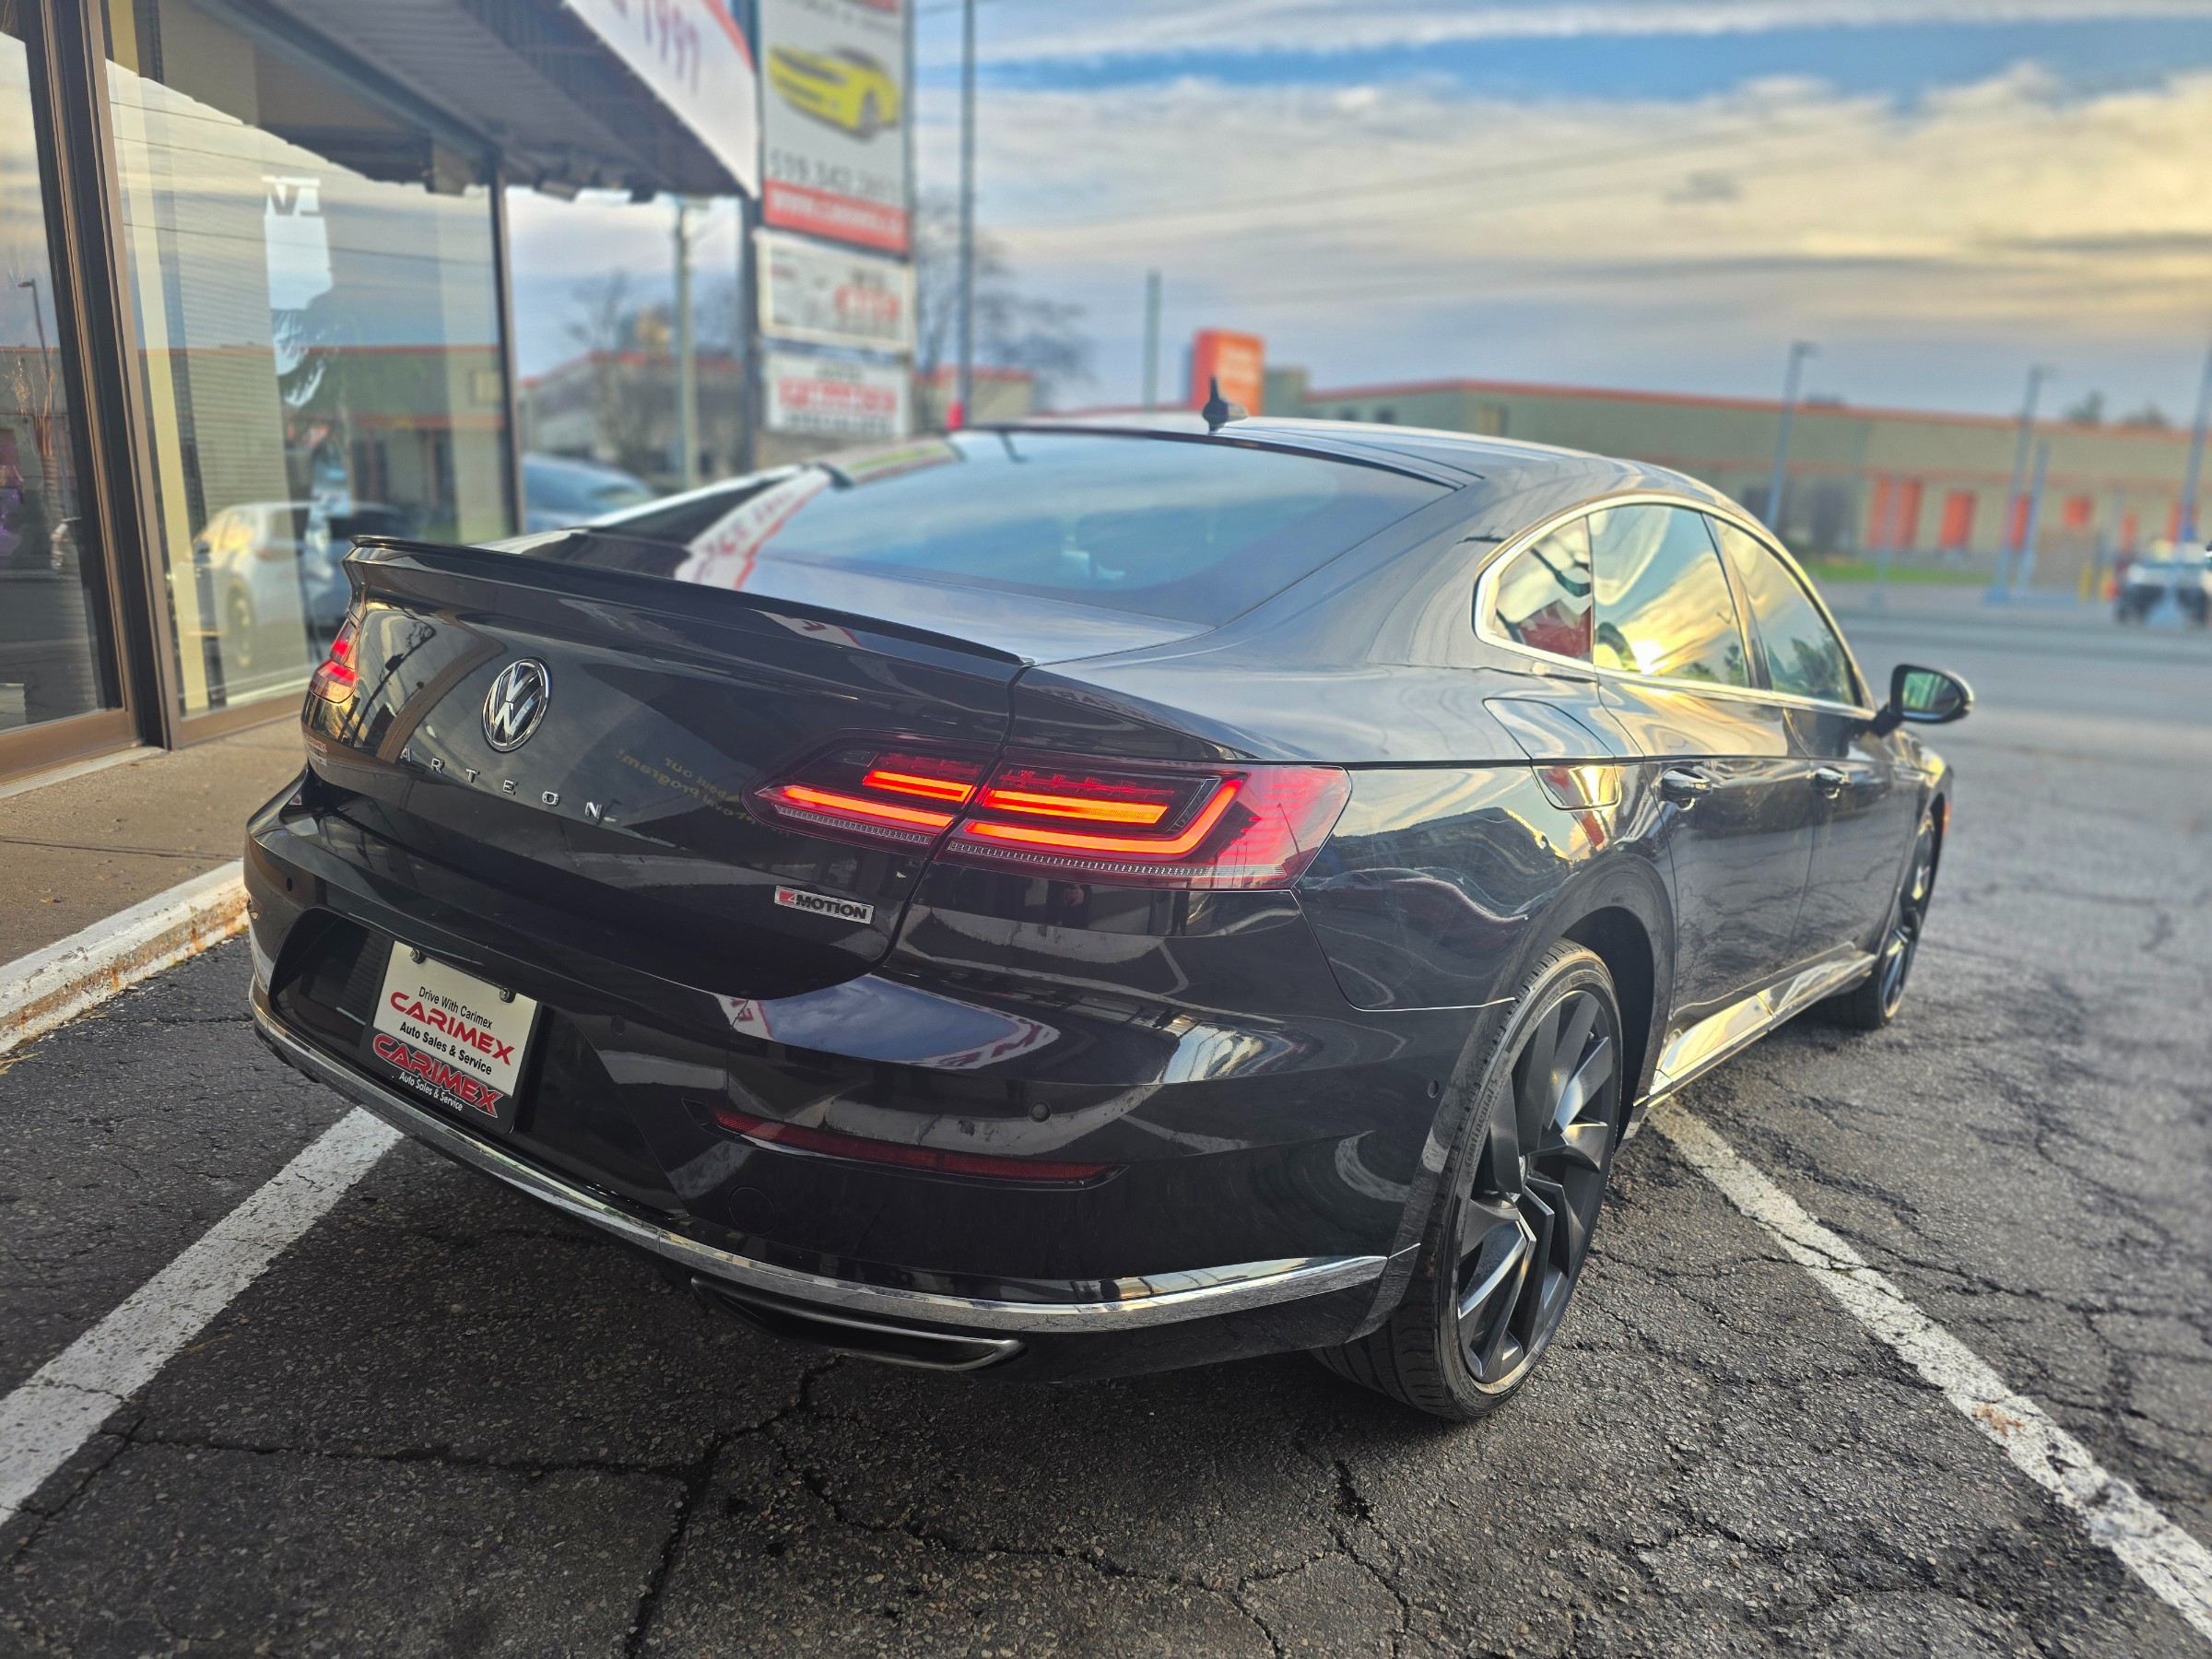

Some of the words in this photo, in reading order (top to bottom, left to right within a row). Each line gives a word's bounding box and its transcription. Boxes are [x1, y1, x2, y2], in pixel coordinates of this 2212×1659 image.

[400, 747, 603, 819] ARTEON
[390, 991, 515, 1066] CARIMEX
[418, 986, 440, 1005] Drive
[441, 995, 459, 1014] With
[460, 1005, 493, 1030] Carimex
[373, 1033, 503, 1117] CARIMEX
[399, 1021, 421, 1040] Auto
[422, 1031, 447, 1053] Sales
[449, 1044, 456, 1058] &
[458, 1049, 492, 1076] Service
[398, 1071, 415, 1087] Auto
[416, 1078, 433, 1096] Sales
[433, 1086, 440, 1100] &
[440, 1091, 464, 1112] Service
